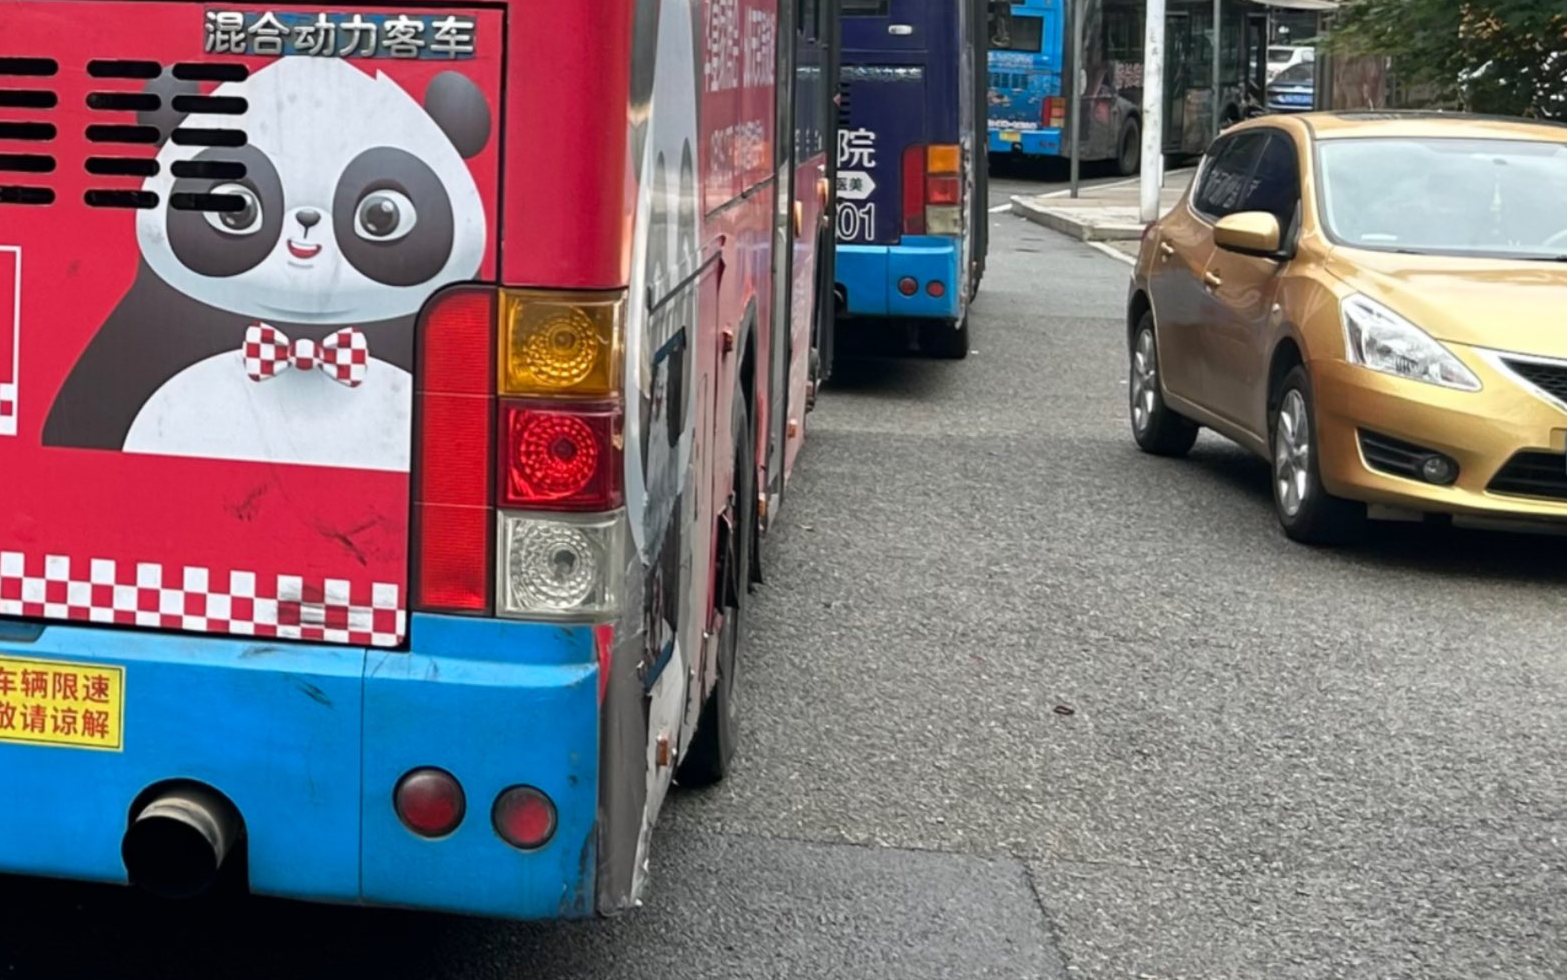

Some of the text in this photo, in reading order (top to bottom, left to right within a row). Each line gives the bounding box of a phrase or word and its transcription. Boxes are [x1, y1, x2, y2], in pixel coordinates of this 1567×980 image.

[205, 10, 476, 59] 混合动力客车
